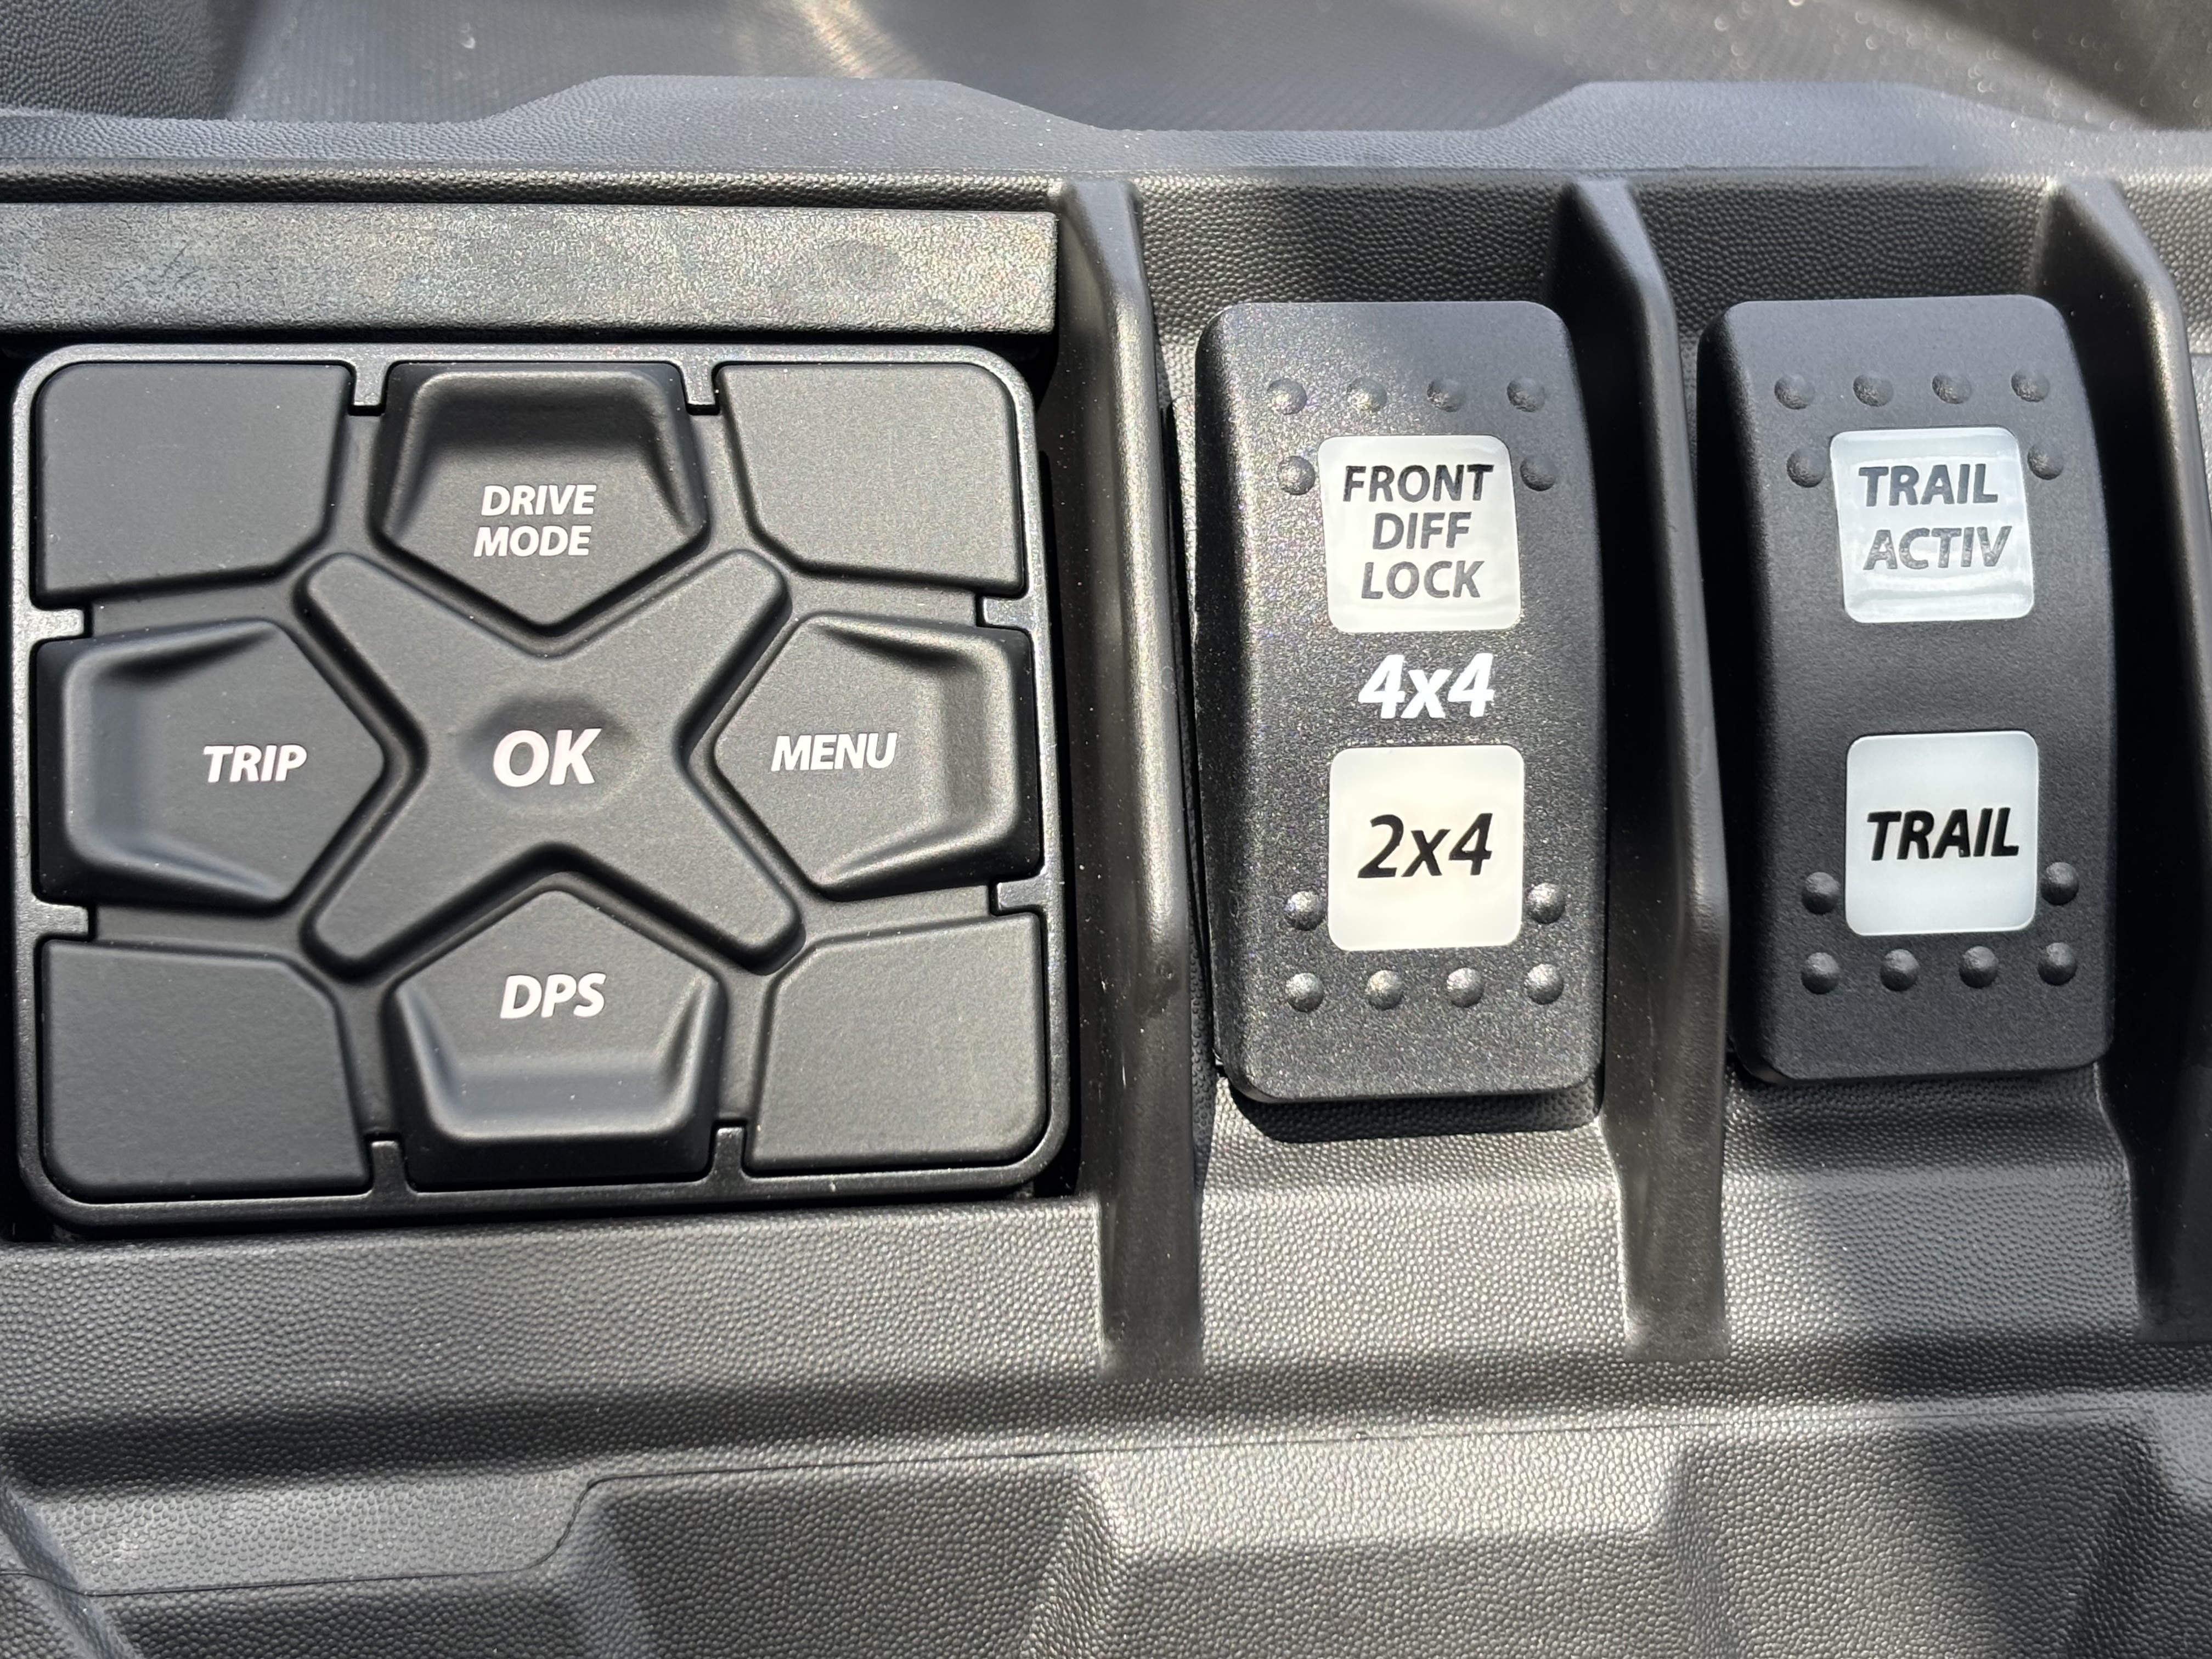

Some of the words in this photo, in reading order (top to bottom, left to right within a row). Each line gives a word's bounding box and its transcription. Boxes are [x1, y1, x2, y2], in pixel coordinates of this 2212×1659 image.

[482, 485, 596, 515] DRIVE
[1344, 464, 1494, 502] FRONT
[1859, 464, 1998, 506] TRAIL
[474, 526, 591, 556] MODE
[1373, 512, 1471, 550] DIFF
[1863, 526, 2012, 570] ACTIV
[1362, 561, 1484, 599] LOCK
[1358, 653, 1496, 718] 4x4
[204, 745, 306, 782] TRIP
[493, 729, 601, 787] OK
[771, 733, 897, 771] MENU
[1358, 813, 1492, 878] 2x4
[1867, 808, 2019, 861] TRAIL
[500, 973, 606, 1018] DPS
